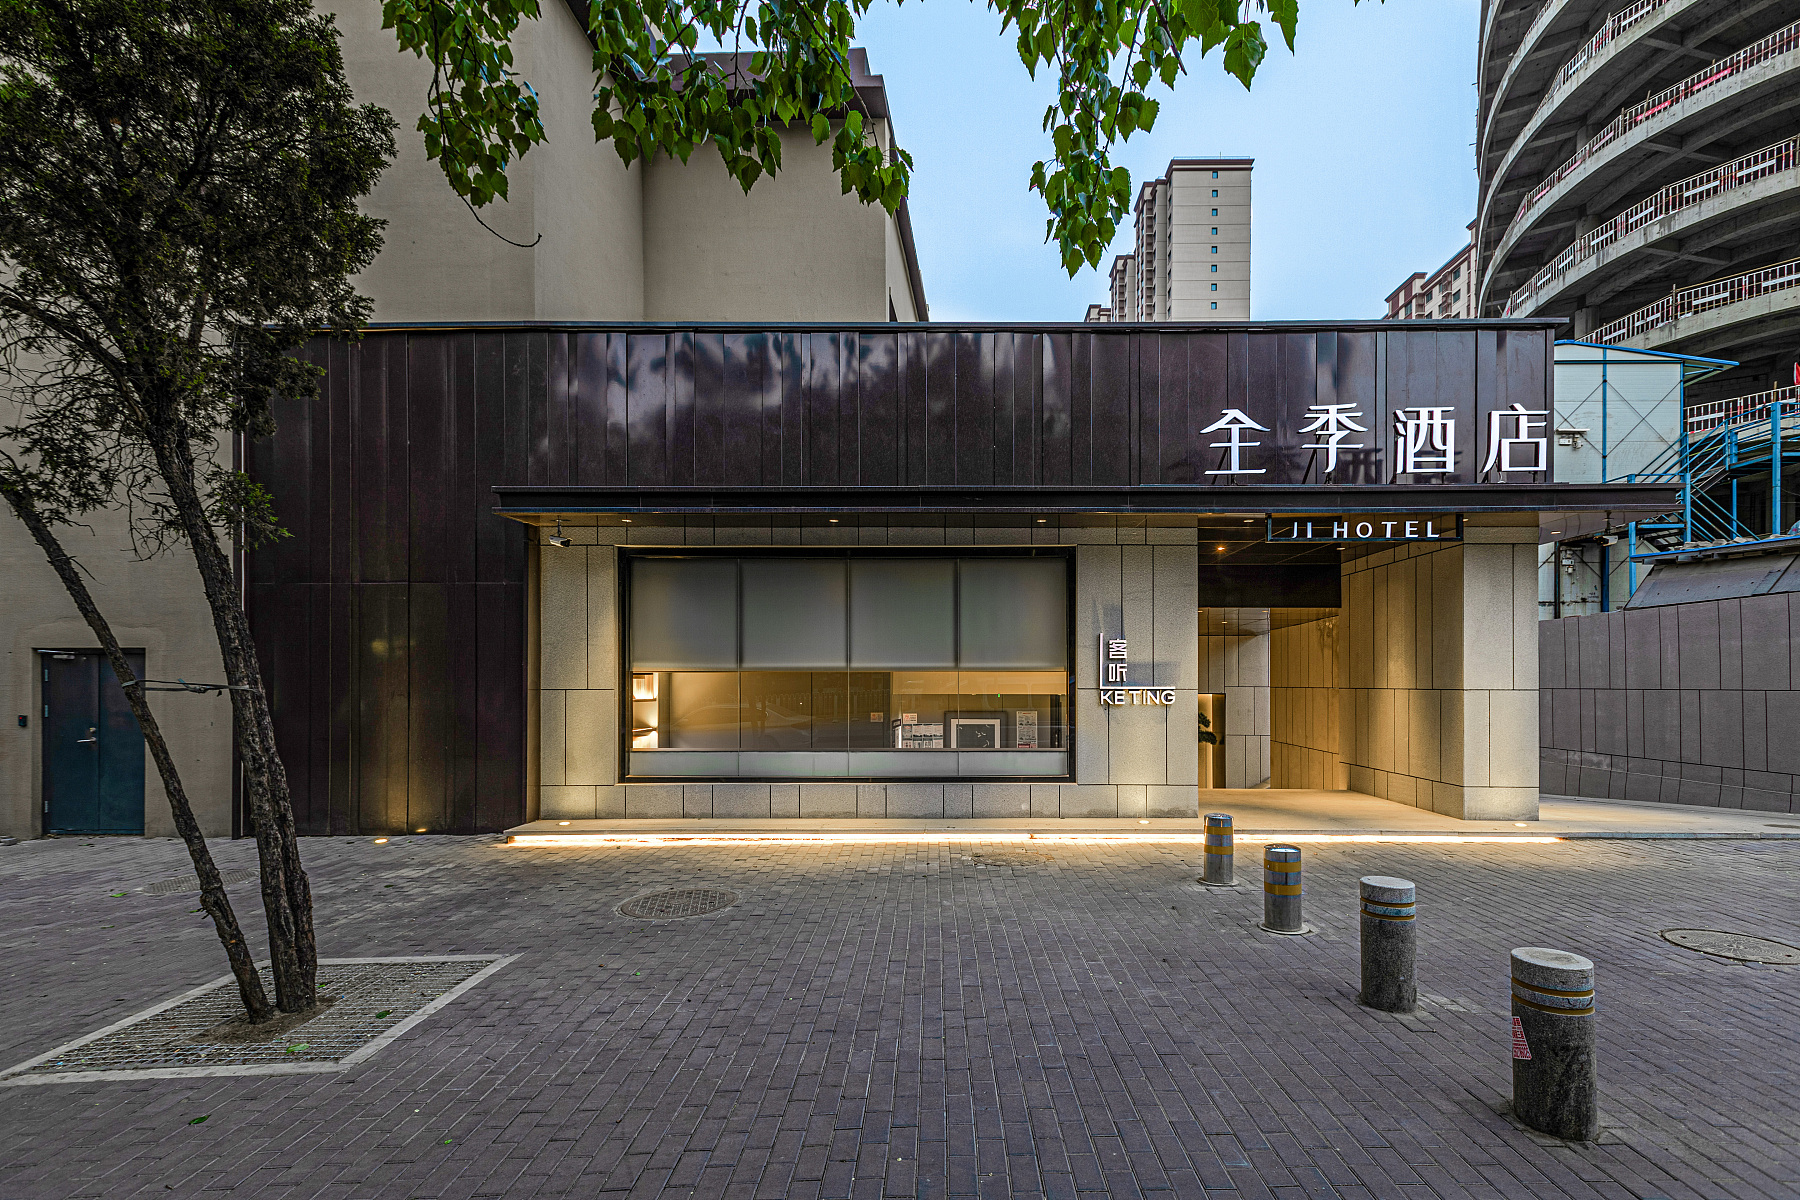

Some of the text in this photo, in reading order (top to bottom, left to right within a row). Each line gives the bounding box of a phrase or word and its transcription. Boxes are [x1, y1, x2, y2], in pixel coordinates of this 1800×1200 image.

[1199, 402, 1551, 474] 全季酒店
[1292, 521, 1440, 539] JI HOTEL
